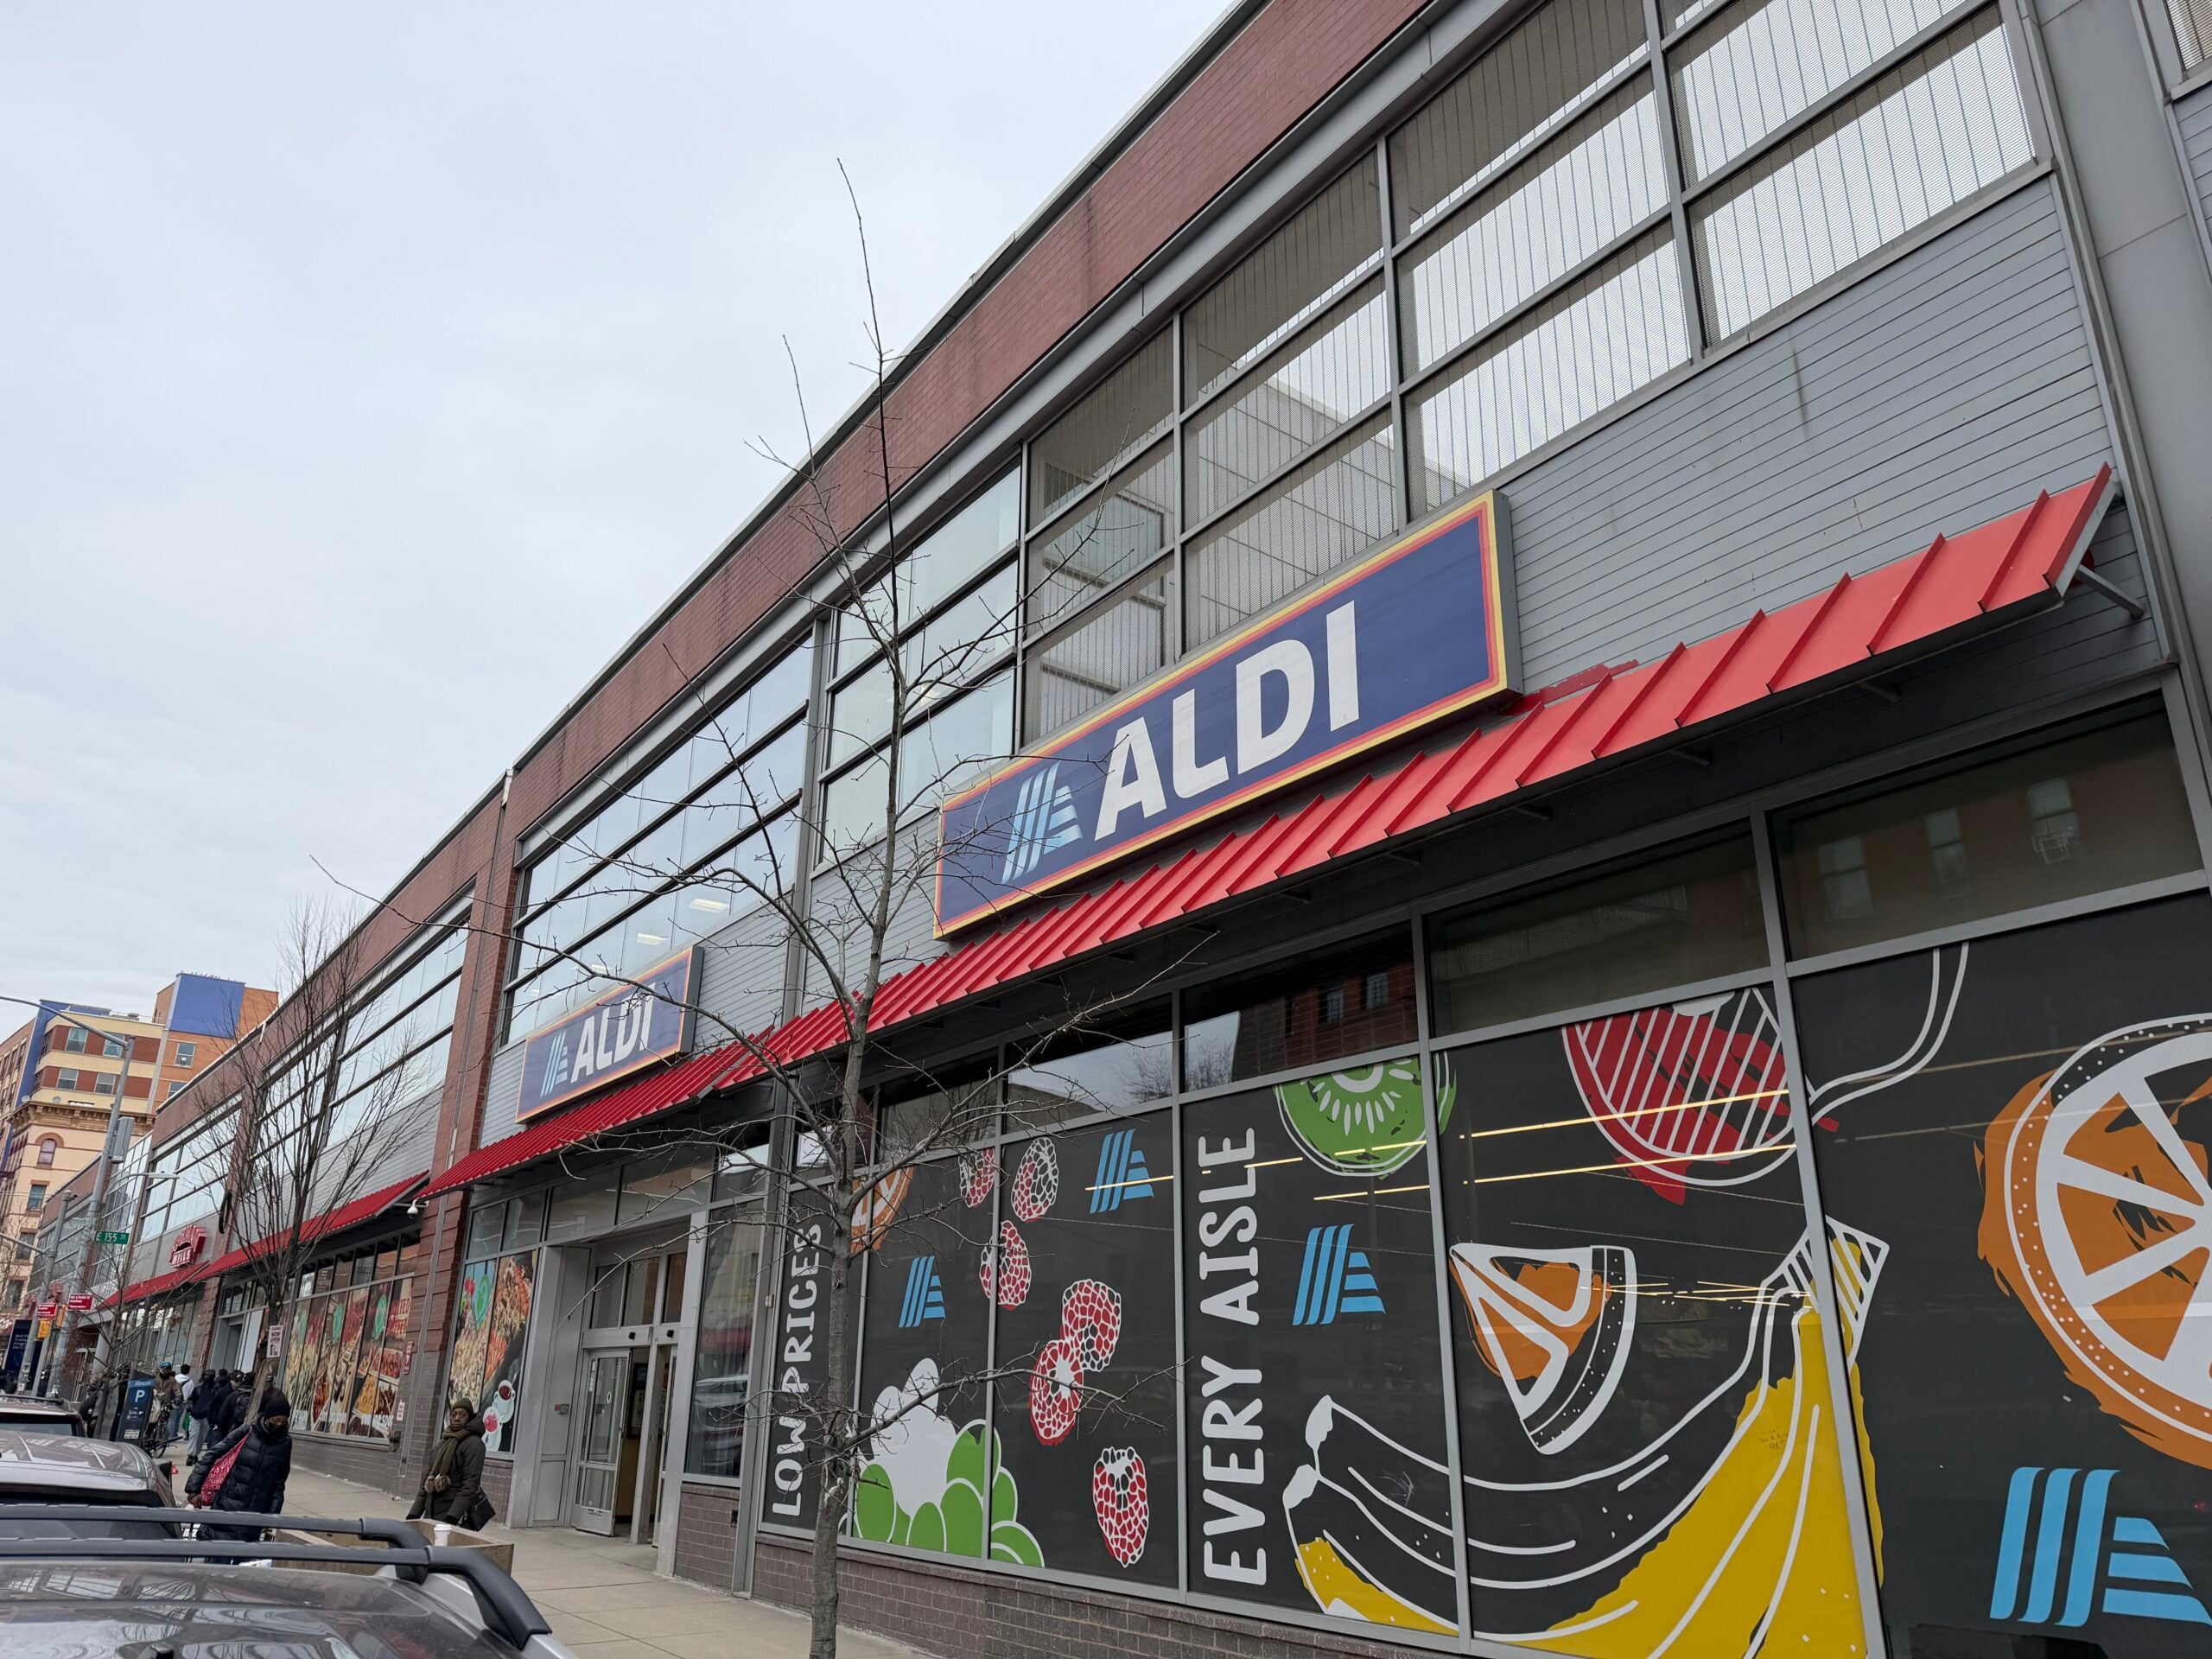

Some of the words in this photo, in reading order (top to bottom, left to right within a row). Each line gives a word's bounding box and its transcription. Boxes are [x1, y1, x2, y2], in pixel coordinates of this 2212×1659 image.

[1095, 601, 1360, 841] ALDI
[570, 982, 656, 1083] ALDI
[96, 1232, 102, 1241] E
[105, 1233, 118, 1242] 155
[1198, 1127, 1260, 1325] AISLE
[781, 1224, 822, 1393] PRICES
[135, 1389, 145, 1402] P
[772, 1415, 806, 1516] LOW
[1201, 1355, 1267, 1586] EVERY
